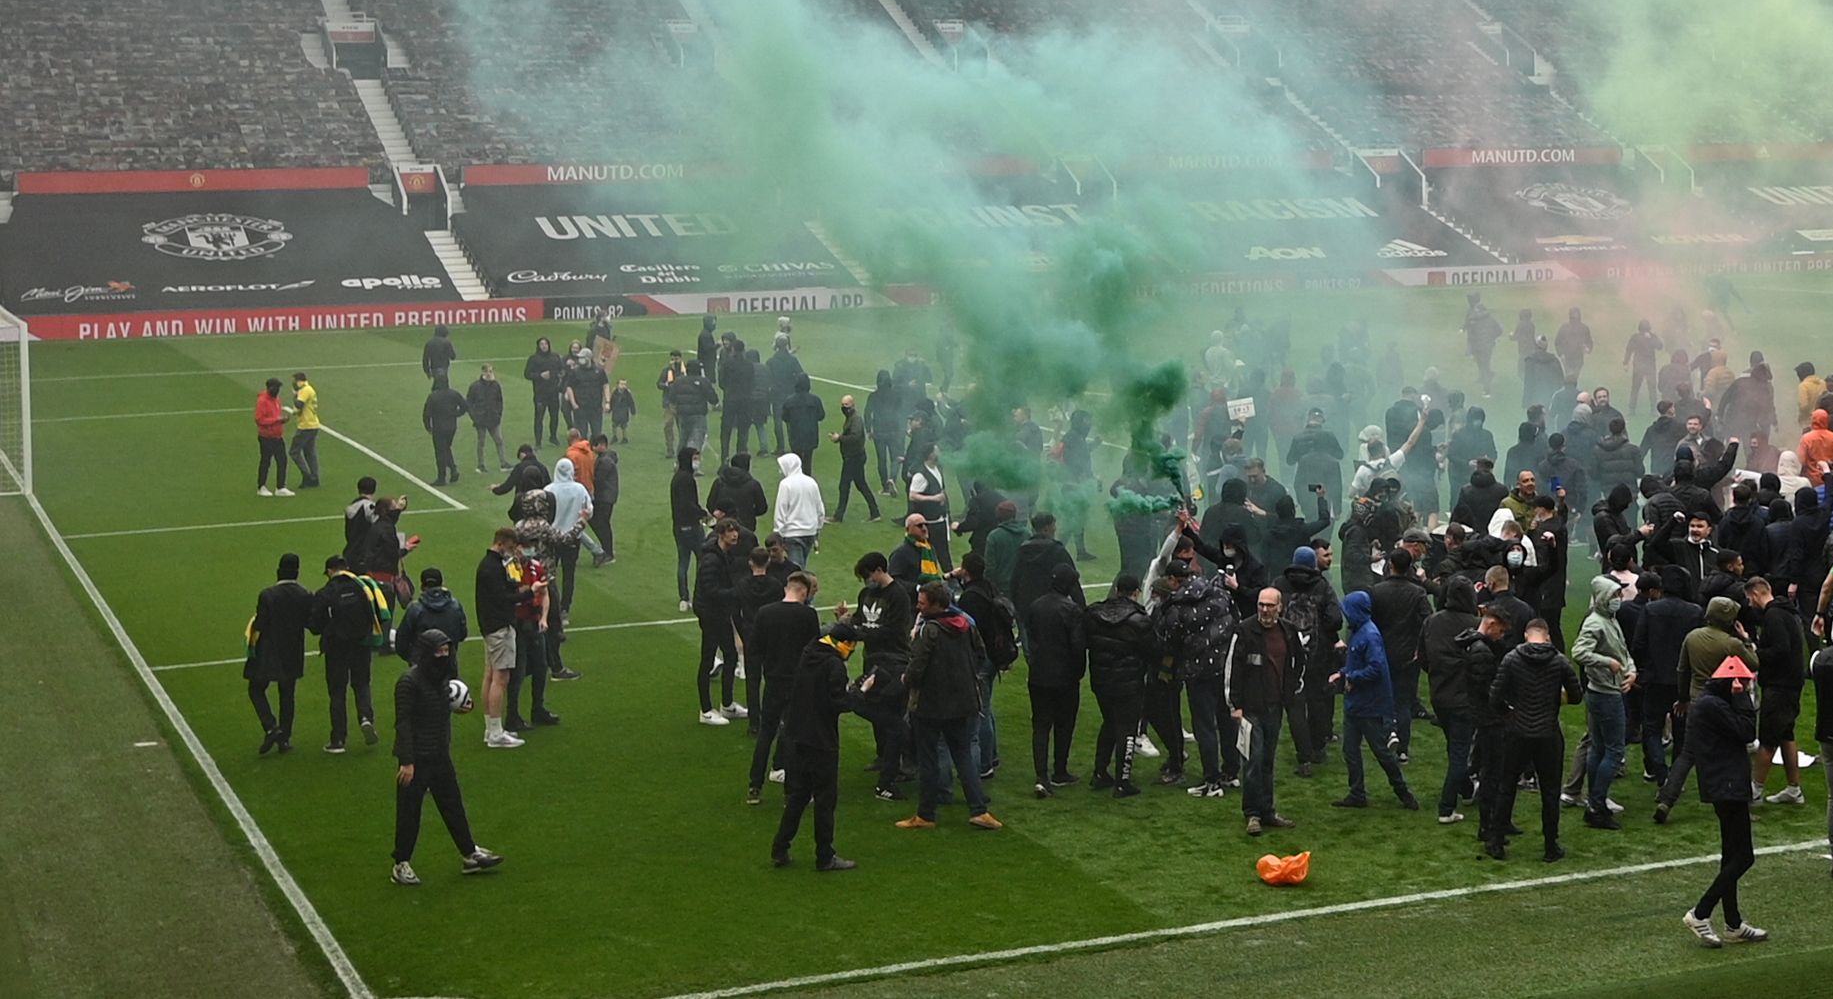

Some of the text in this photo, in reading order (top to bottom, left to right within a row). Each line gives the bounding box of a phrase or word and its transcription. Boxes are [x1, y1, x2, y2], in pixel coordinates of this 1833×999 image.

[1168, 154, 1281, 170] MANUTD.COM
[1472, 149, 1575, 164] MANUTD.COM
[547, 163, 684, 183] MANUTD.COM
[1186, 196, 1381, 221] RACISM
[535, 213, 741, 241] UNITED
[1245, 245, 1326, 260] AON
[620, 263, 700, 273] Casillero
[745, 261, 835, 273] CHIVAS
[341, 274, 441, 290] apollo
[507, 269, 608, 283] Cadbury
[640, 274, 700, 285] Diablo
[1451, 268, 1554, 285] OFFICIAL APP
[161, 284, 281, 293] AEROFLOT
[737, 293, 864, 313] OFFICIAL APP
[79, 321, 131, 340] PLAY
[142, 319, 184, 337] AND
[194, 318, 236, 335] WIN
[247, 315, 300, 332] WITH
[311, 312, 384, 330] UNITED
[395, 306, 527, 326] PREDICTIONS
